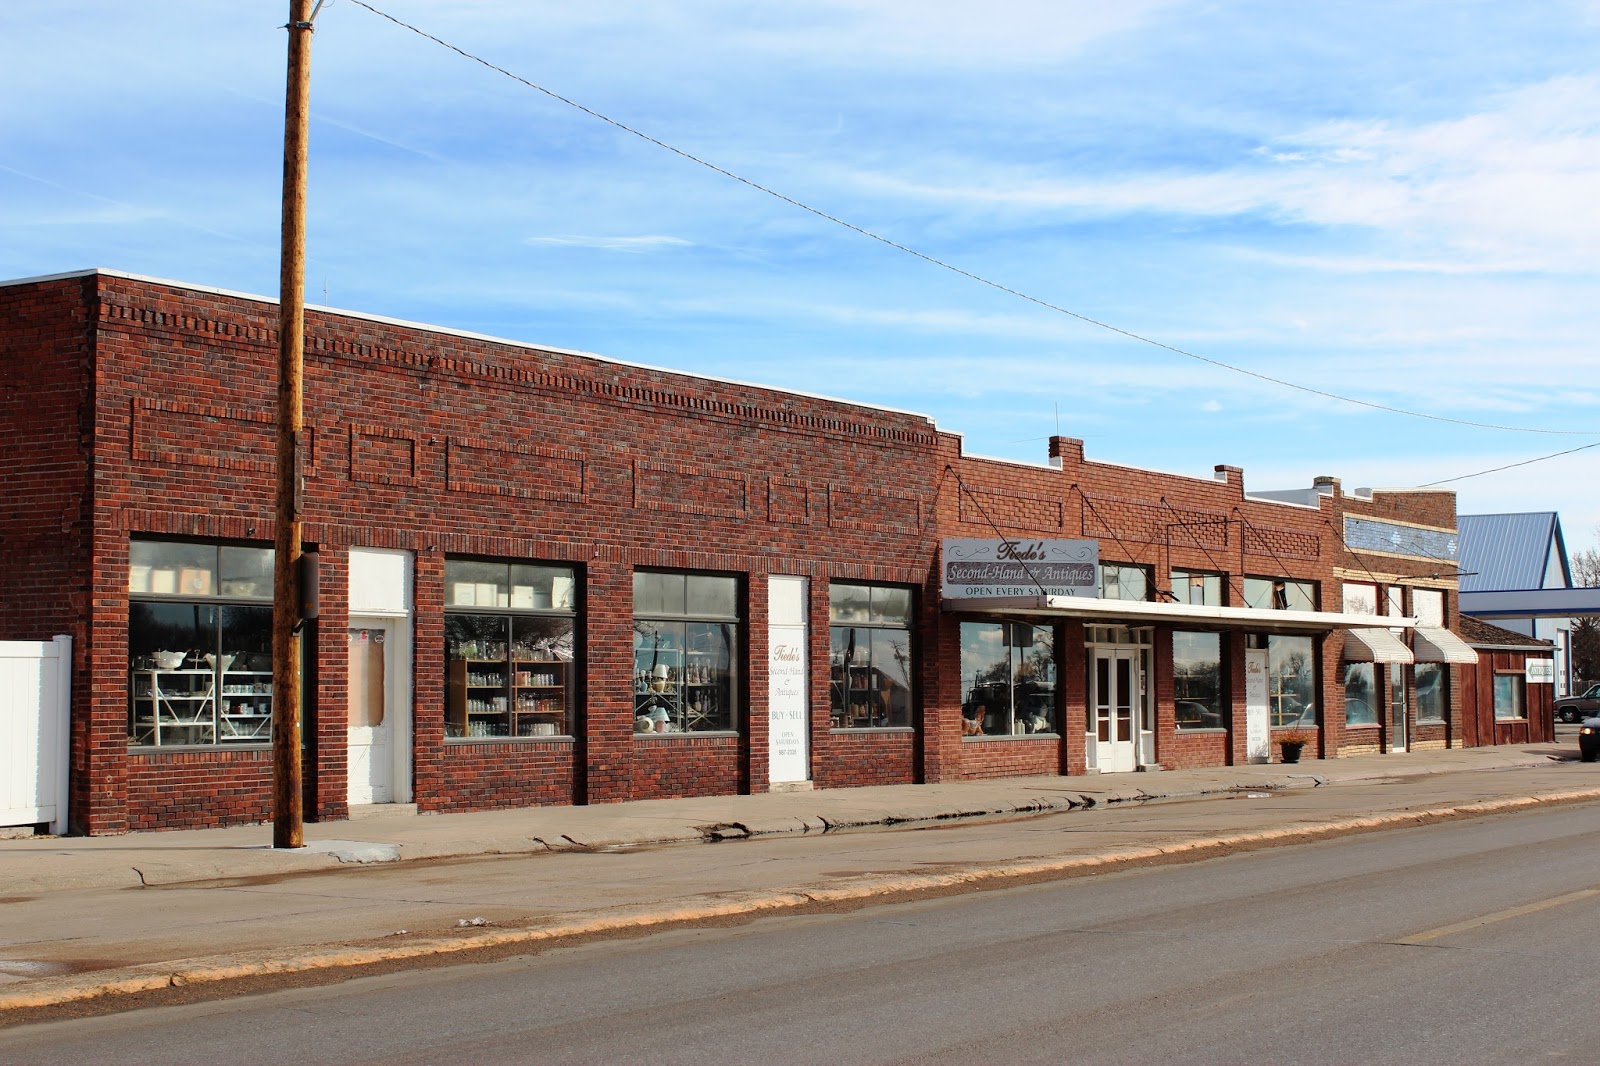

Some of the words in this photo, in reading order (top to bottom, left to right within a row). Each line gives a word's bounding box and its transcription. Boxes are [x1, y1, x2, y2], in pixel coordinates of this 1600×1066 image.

[996, 541, 1046, 561] Tiede's
[948, 563, 1024, 580] Second-Hand
[1042, 565, 1094, 585] Antiques
[965, 587, 993, 596] OPEN
[996, 587, 1025, 596] EVERY
[773, 644, 800, 661] Tiede's
[771, 710, 784, 720] BUY
[789, 710, 802, 720] SELL
